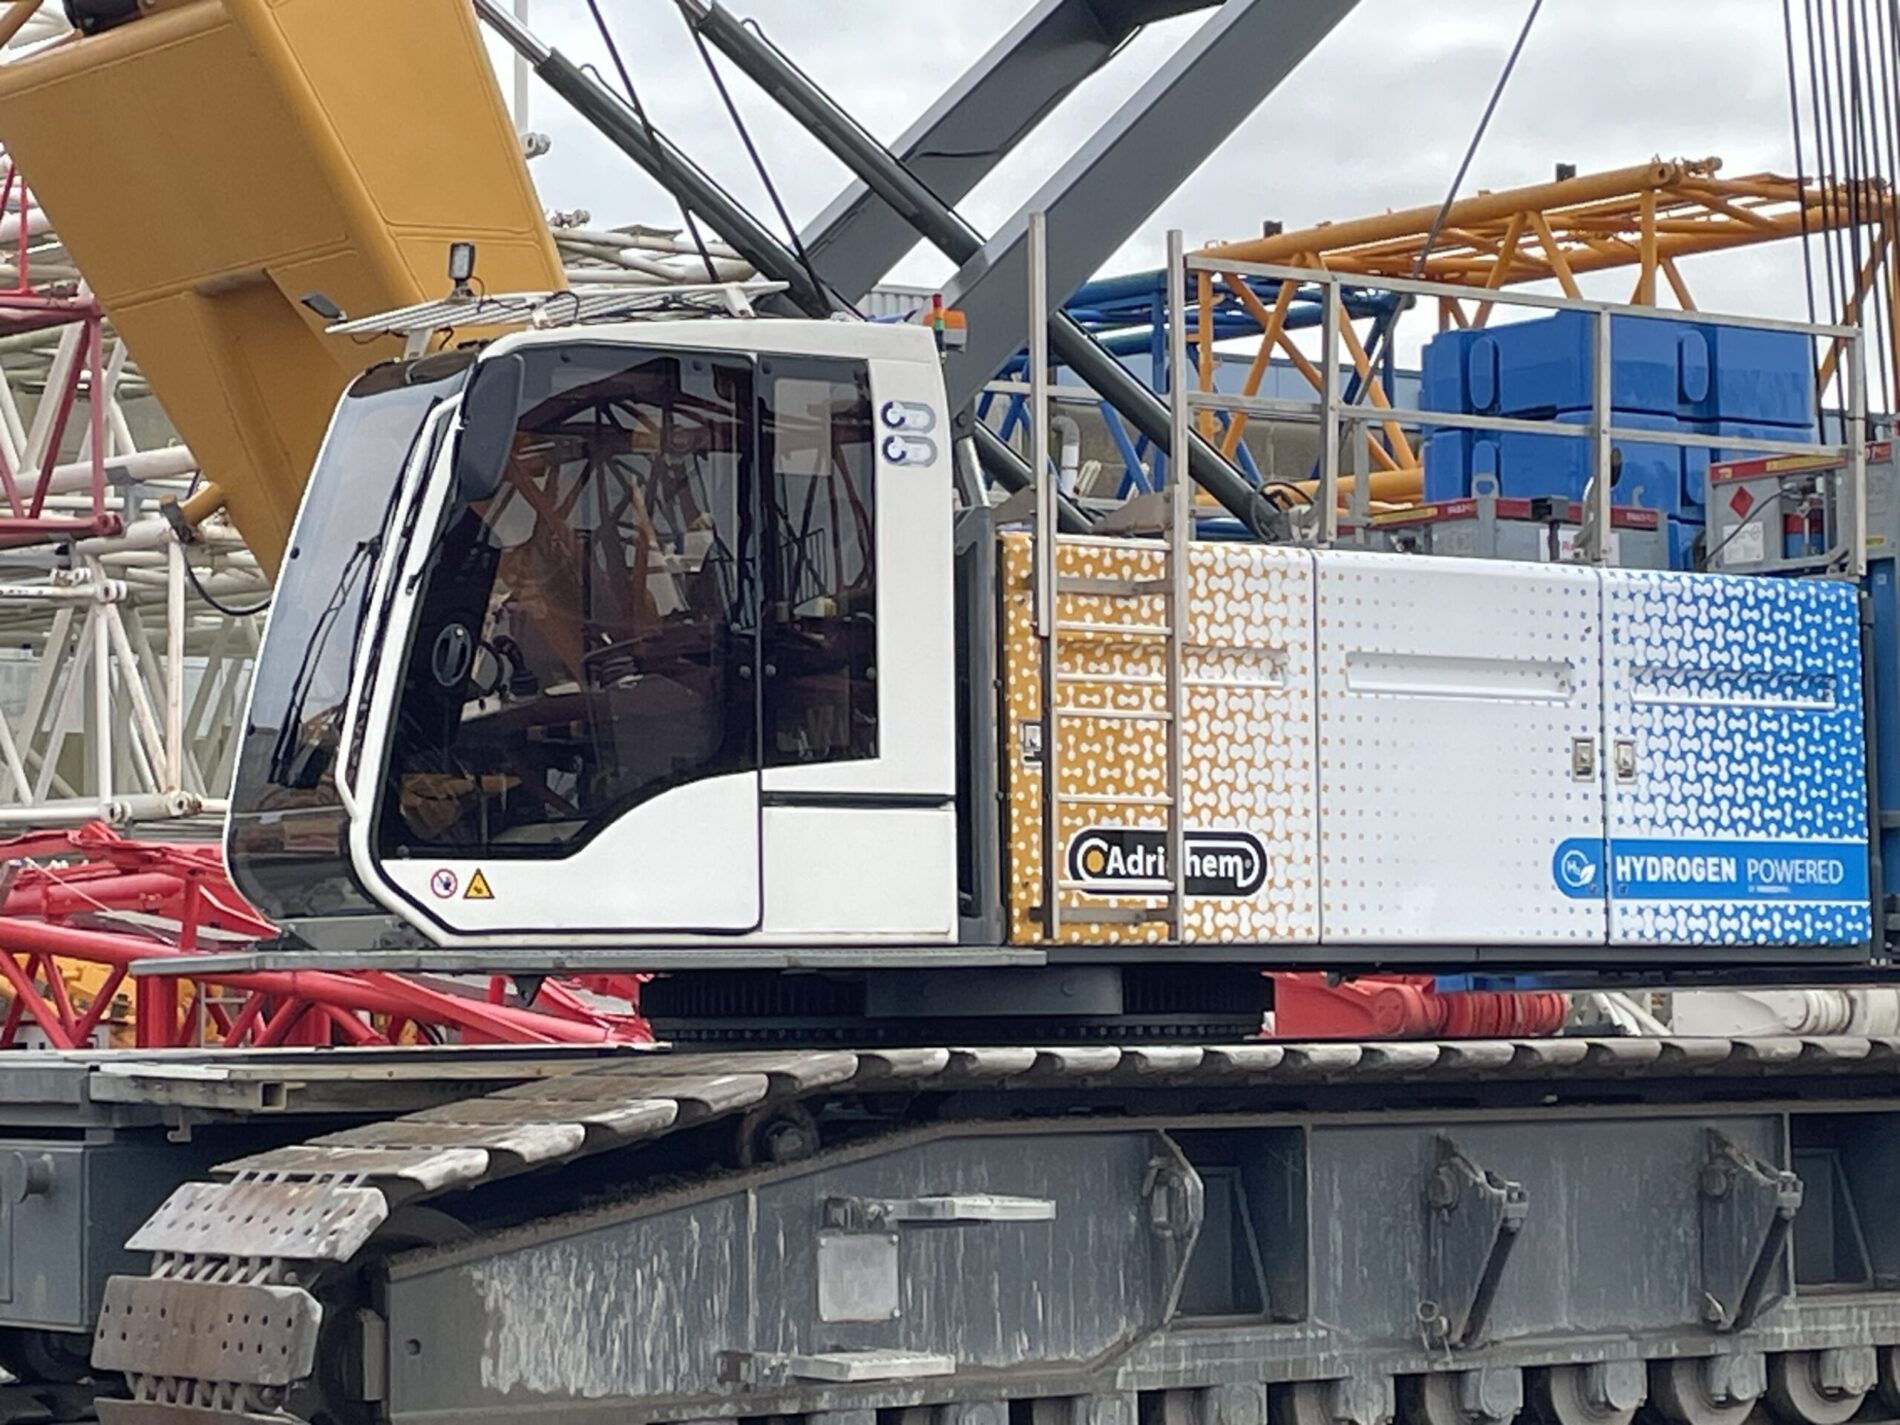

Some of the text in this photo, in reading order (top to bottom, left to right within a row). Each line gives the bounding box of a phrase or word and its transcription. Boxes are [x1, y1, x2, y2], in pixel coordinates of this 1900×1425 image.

[1105, 844, 1244, 883] Adrihem
[1616, 855, 1844, 884] HYDROGEN POWERED
